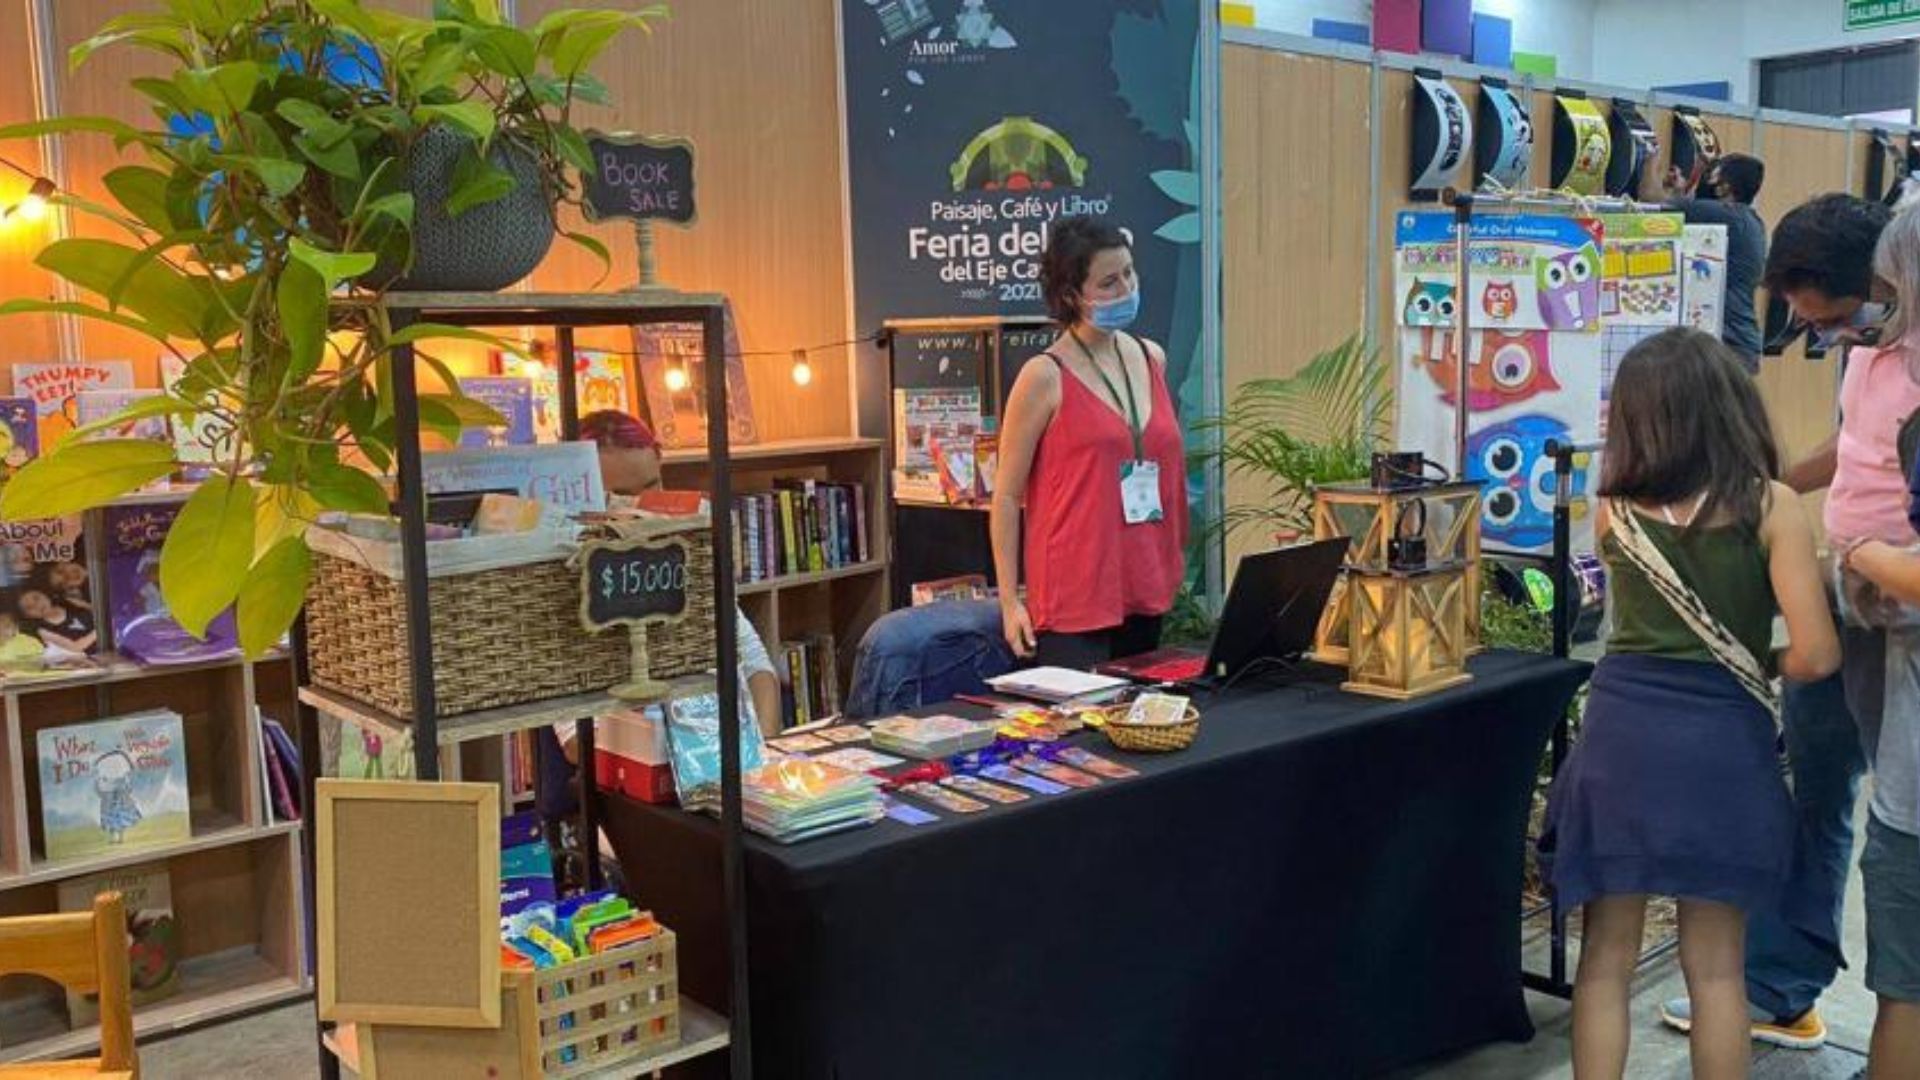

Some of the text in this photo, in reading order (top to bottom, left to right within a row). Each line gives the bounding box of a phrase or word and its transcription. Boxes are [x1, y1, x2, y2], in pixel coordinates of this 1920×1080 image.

[909, 39, 958, 56] Amor
[602, 152, 669, 186] BOOK
[628, 187, 680, 213] SALE
[931, 200, 997, 225] Paisaje,
[1000, 196, 1042, 219] Café
[1045, 203, 1059, 219] y
[909, 221, 1049, 260] Feria del
[940, 258, 1044, 286] del Eje Ca
[999, 282, 1042, 301] 2021
[21, 366, 111, 391] THUMPY
[36, 543, 73, 560] Me
